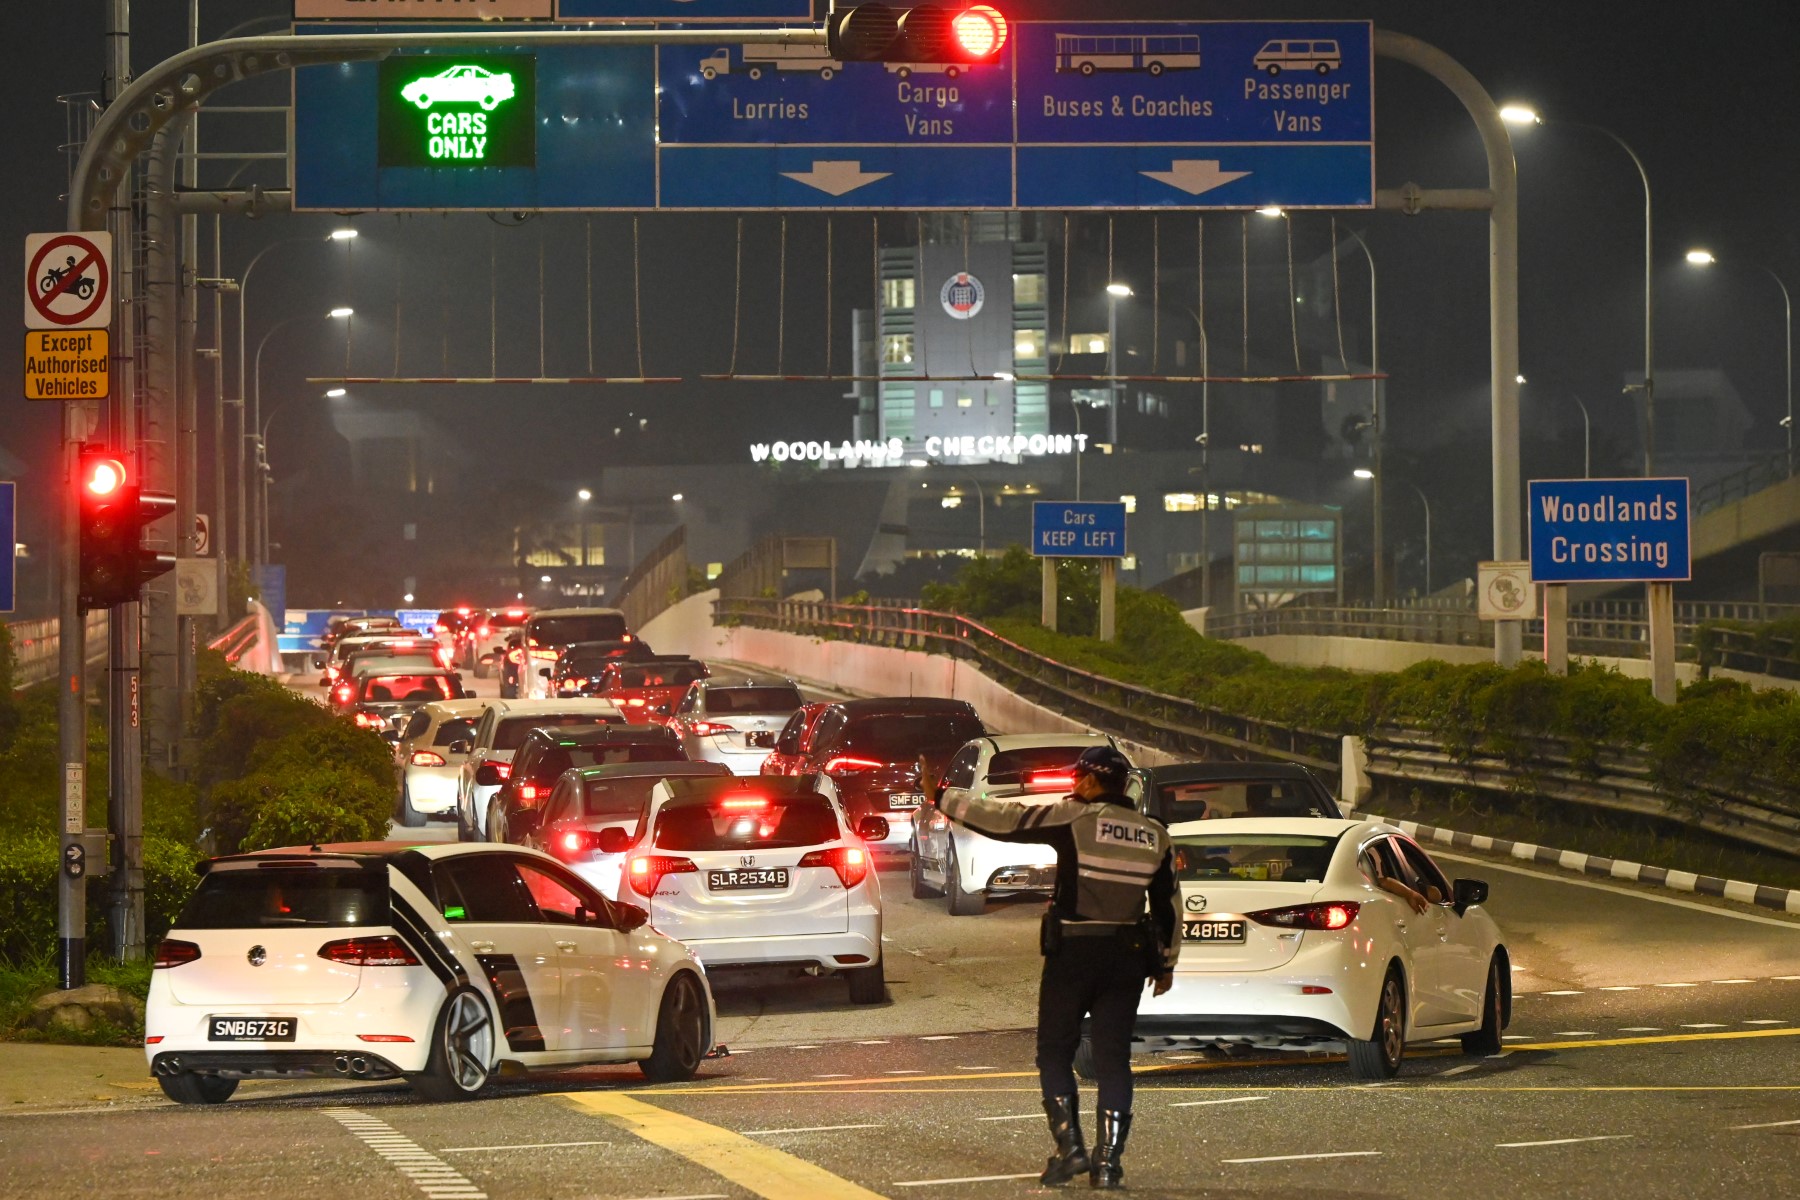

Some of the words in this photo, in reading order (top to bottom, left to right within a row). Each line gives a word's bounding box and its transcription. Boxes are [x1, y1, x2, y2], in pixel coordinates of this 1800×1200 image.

[898, 82, 959, 108] Cargo
[1244, 78, 1350, 104] Passenger
[733, 98, 809, 119] Lorries
[1043, 95, 1103, 117] Buses
[1111, 95, 1124, 117] &
[1132, 95, 1212, 117] Coaches
[428, 112, 486, 134] CARS
[905, 115, 953, 135] Vans
[1274, 110, 1322, 132] Vans
[429, 136, 486, 158] ONLY
[41, 333, 92, 355] Except
[26, 355, 107, 374] Authorised
[35, 377, 97, 396] Vehicles
[750, 438, 904, 462] WOODLANDS
[926, 433, 1088, 457] CHECKPOINT
[1064, 509, 1095, 525] Cars
[1541, 494, 1678, 523] Woodlands
[1042, 531, 1076, 547] KEEP
[1084, 531, 1116, 547] LEFT
[1551, 535, 1668, 569] Crossing
[130, 676, 139, 727] 543
[891, 795, 911, 805] SMF
[1101, 823, 1155, 847] POLICE
[214, 1020, 290, 1036] SNB673G
